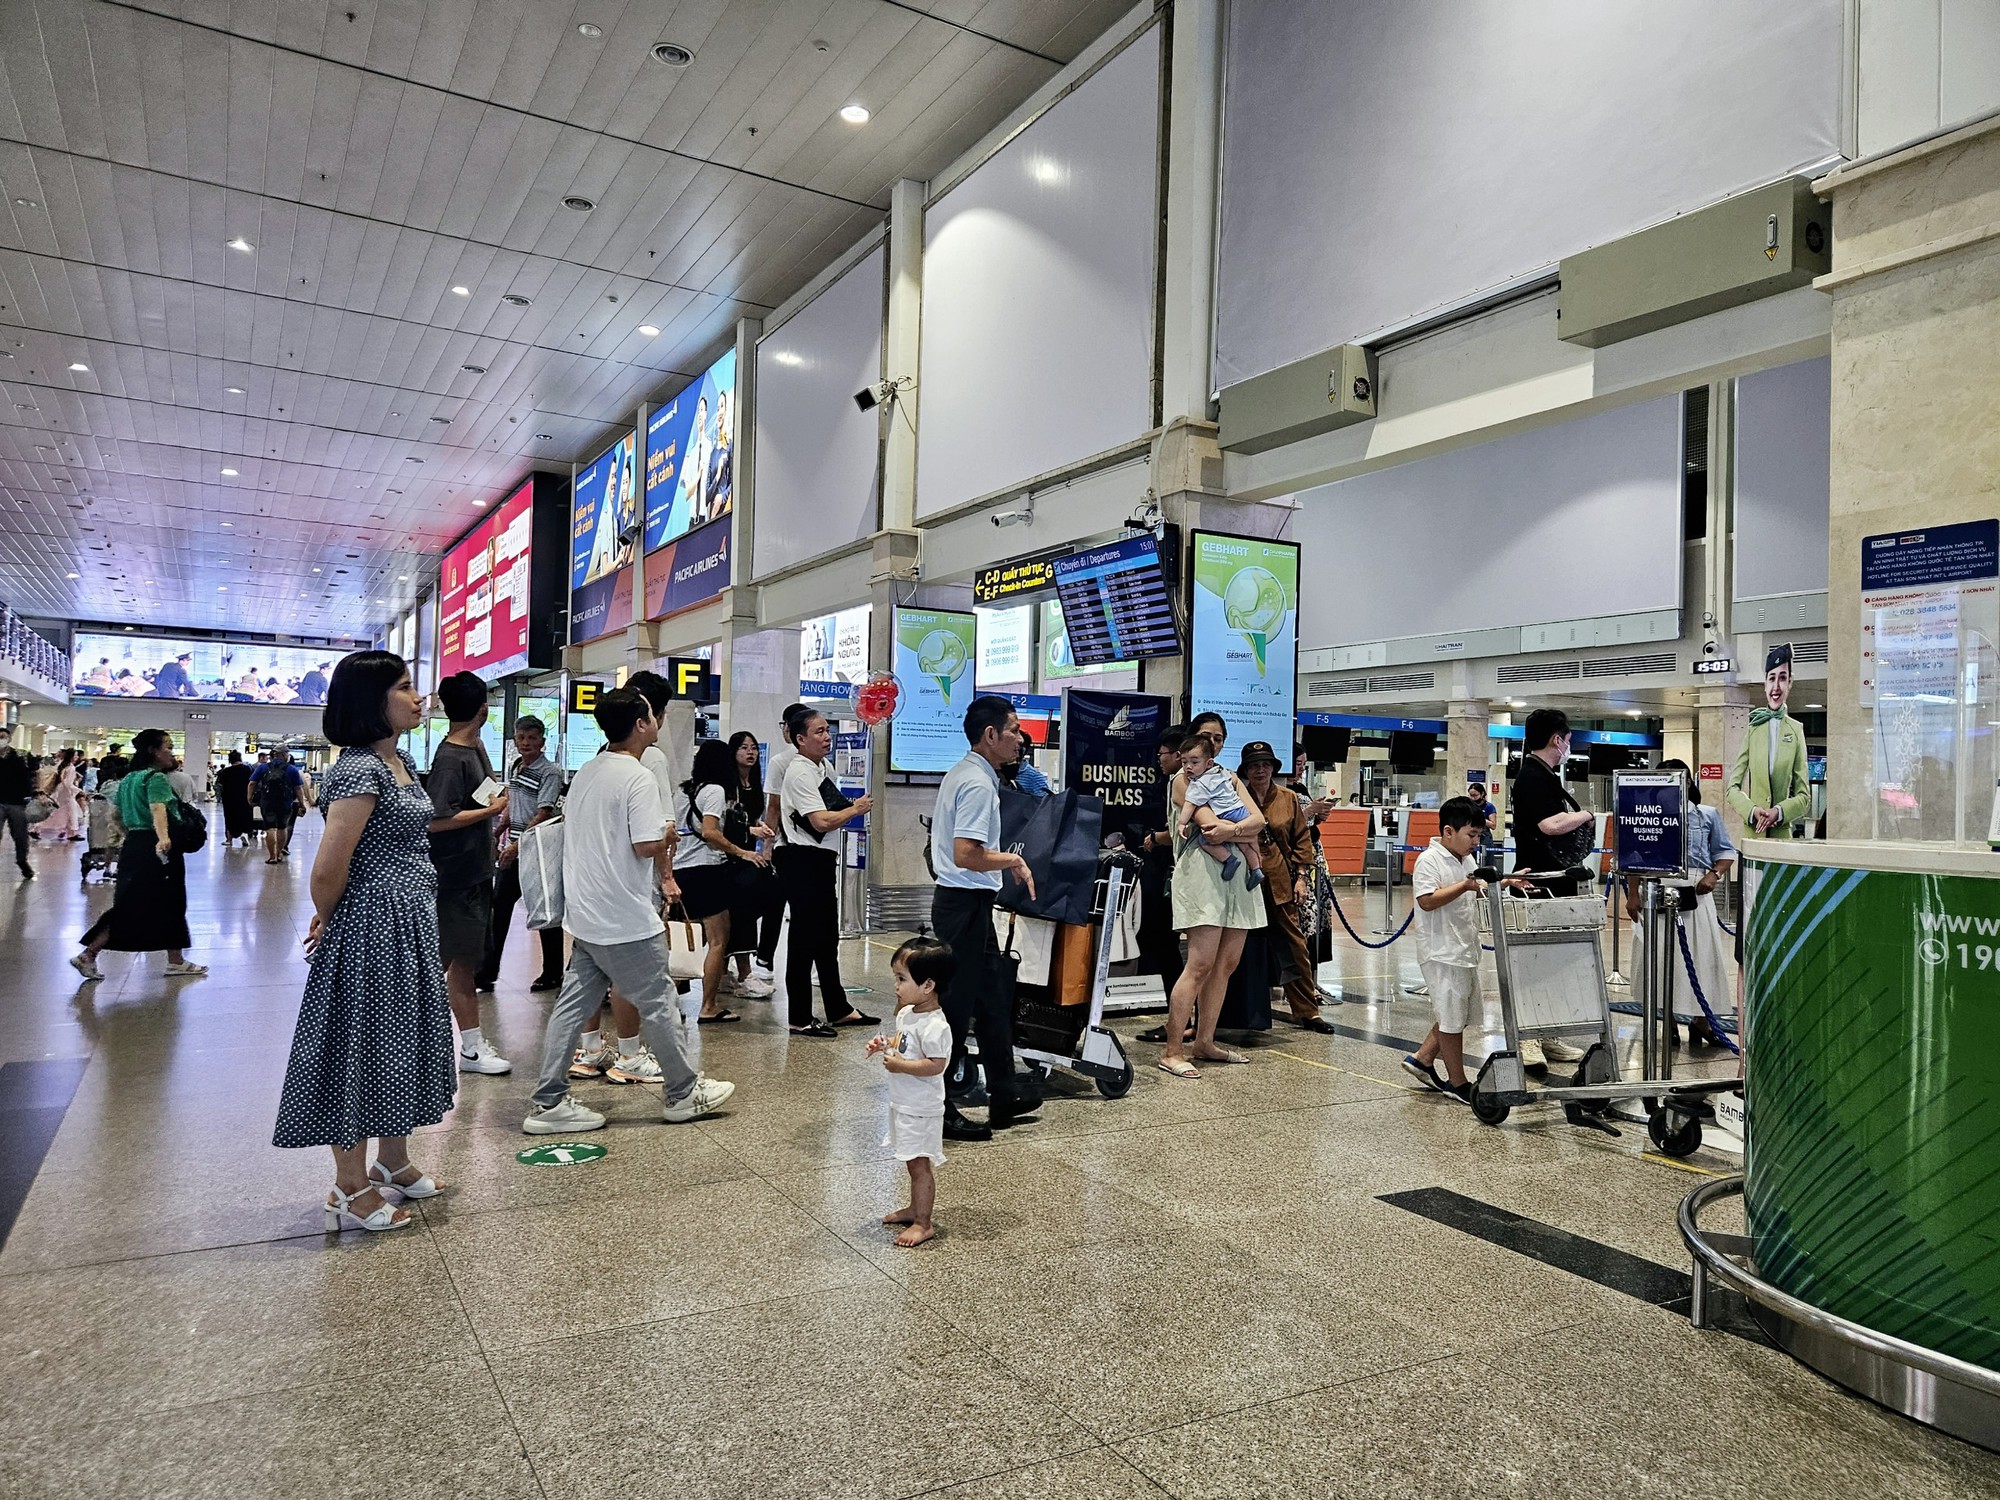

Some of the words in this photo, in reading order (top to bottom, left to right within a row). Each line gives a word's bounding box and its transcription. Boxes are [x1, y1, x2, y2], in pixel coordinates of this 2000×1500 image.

[665, 439, 676, 460] vui
[1140, 540, 1154, 552] 15:01
[1202, 542, 1249, 556] GEBHART
[1060, 558, 1080, 571] Chuyến
[1080, 556, 1086, 566] đi
[1090, 550, 1121, 565] Departures
[985, 570, 1000, 585] C-D
[1045, 564, 1053, 578] G
[984, 585, 998, 600] E-F
[1022, 576, 1046, 588] Counters
[900, 613, 937, 624] GEBHART
[839, 634, 860, 648] KHÔNG
[1698, 661, 1728, 672] 15:03
[678, 663, 701, 695] F
[576, 685, 596, 710] E
[1011, 696, 1027, 706] F-2
[1316, 715, 1329, 724] F-5
[1401, 720, 1414, 729] F-6
[1082, 765, 1156, 784] BUSINESS
[1095, 788, 1143, 806] CLASS
[1636, 805, 1662, 816] HẠNG
[1662, 817, 1679, 826] GIA
[1956, 944, 2000, 972] 19
